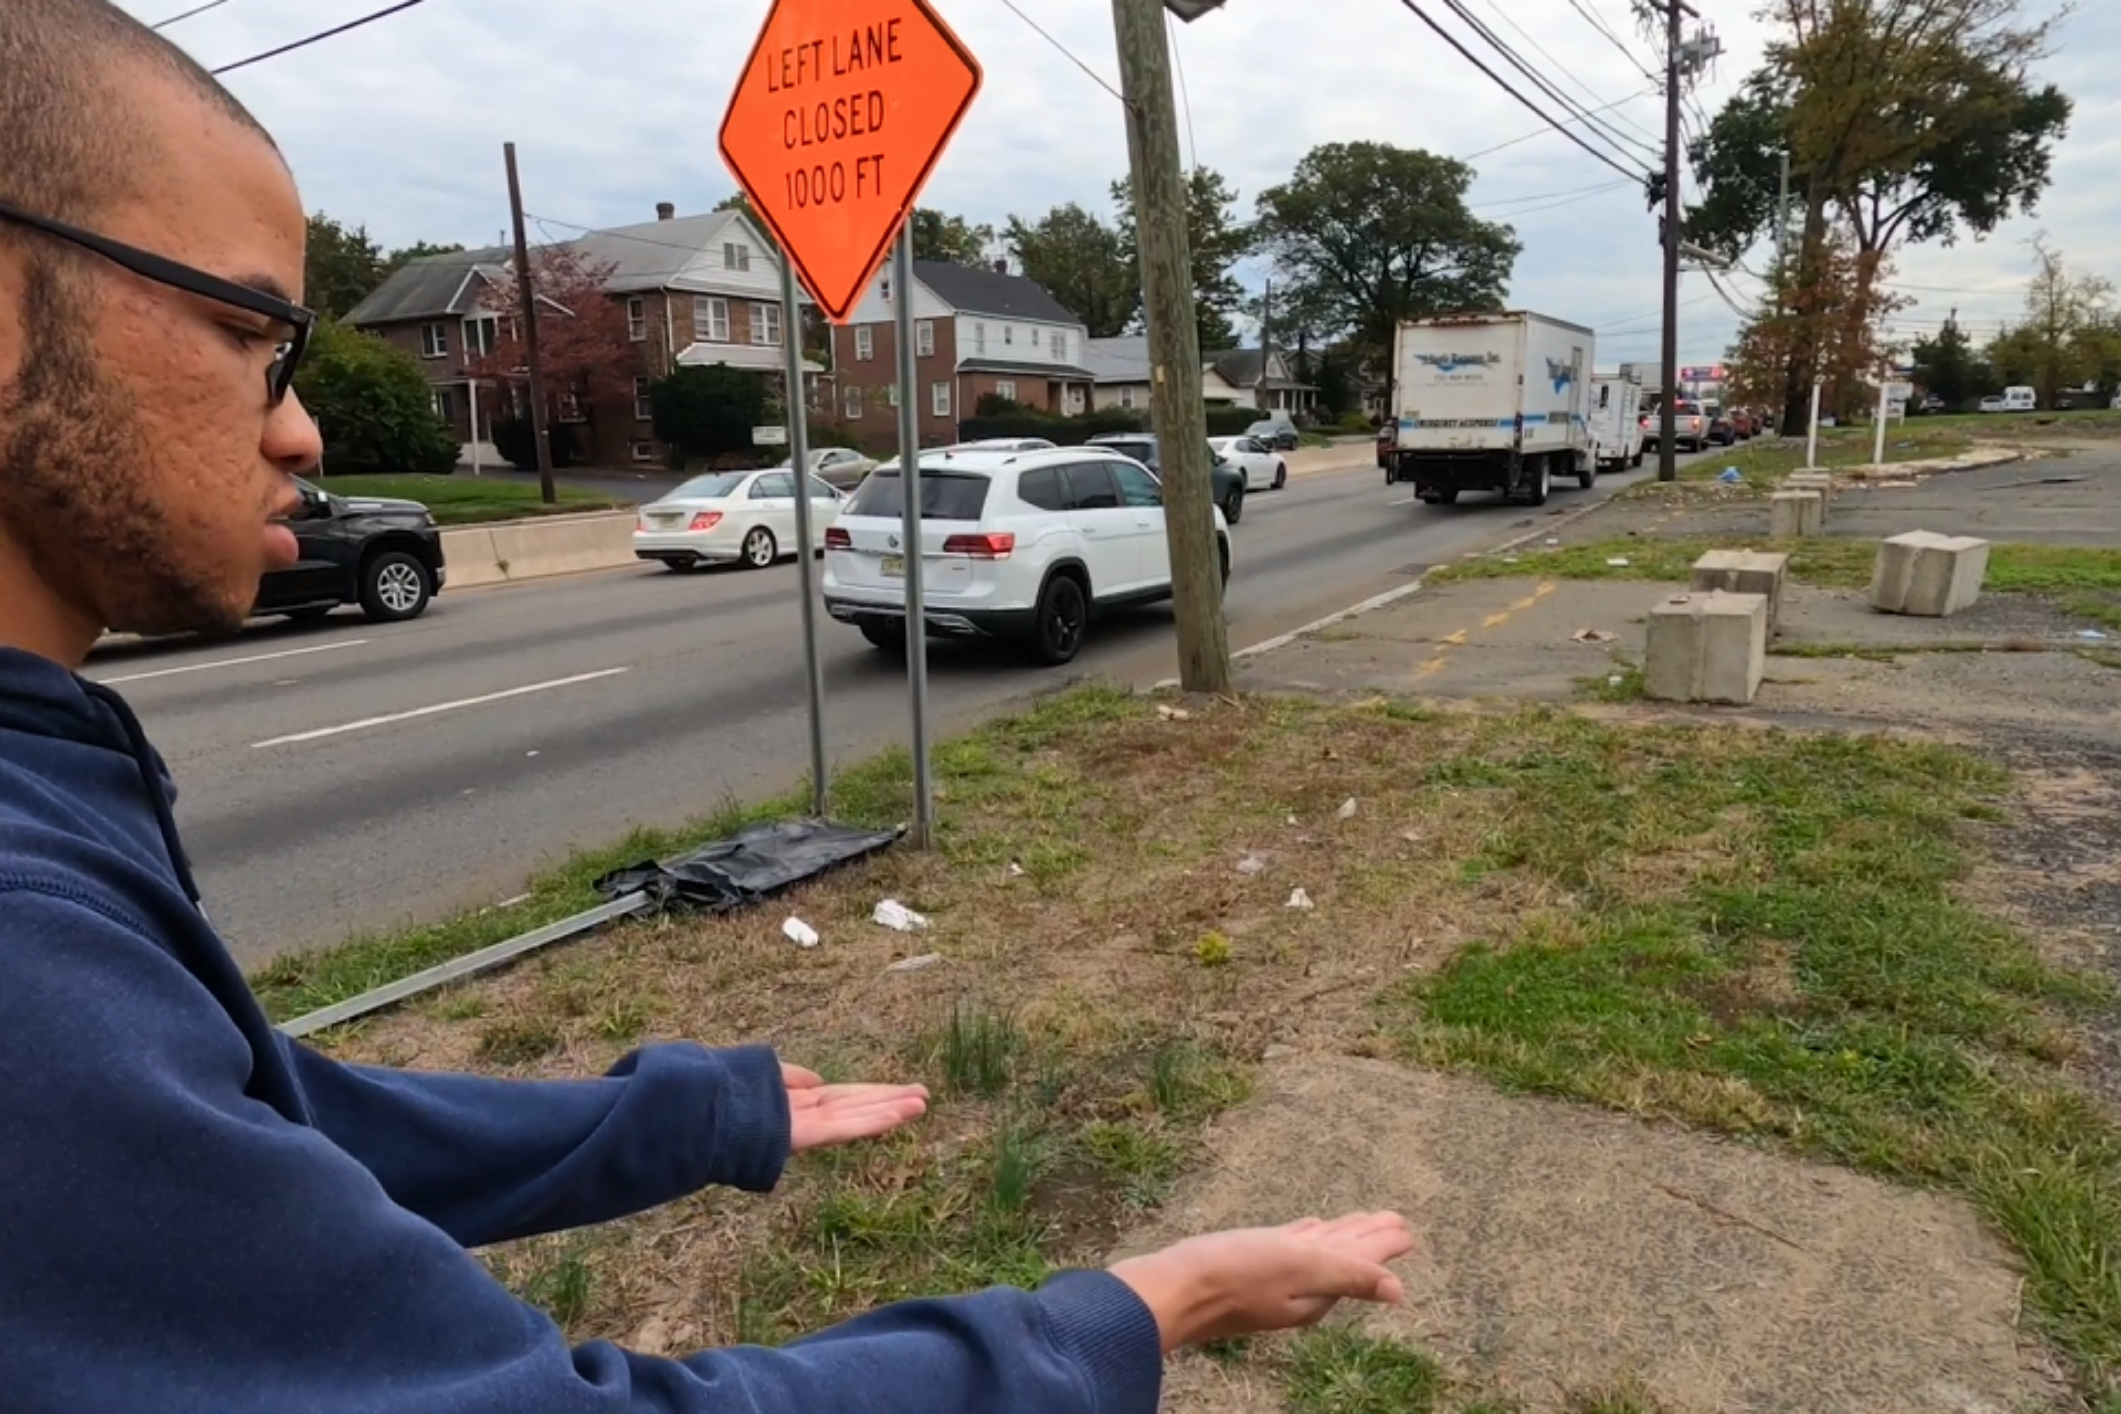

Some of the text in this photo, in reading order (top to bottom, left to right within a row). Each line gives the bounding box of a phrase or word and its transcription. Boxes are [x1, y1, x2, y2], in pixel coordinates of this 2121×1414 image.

[767, 18, 902, 93] LEFT LANE
[784, 90, 885, 149] CLOSED
[785, 154, 885, 210] 1000 FT
